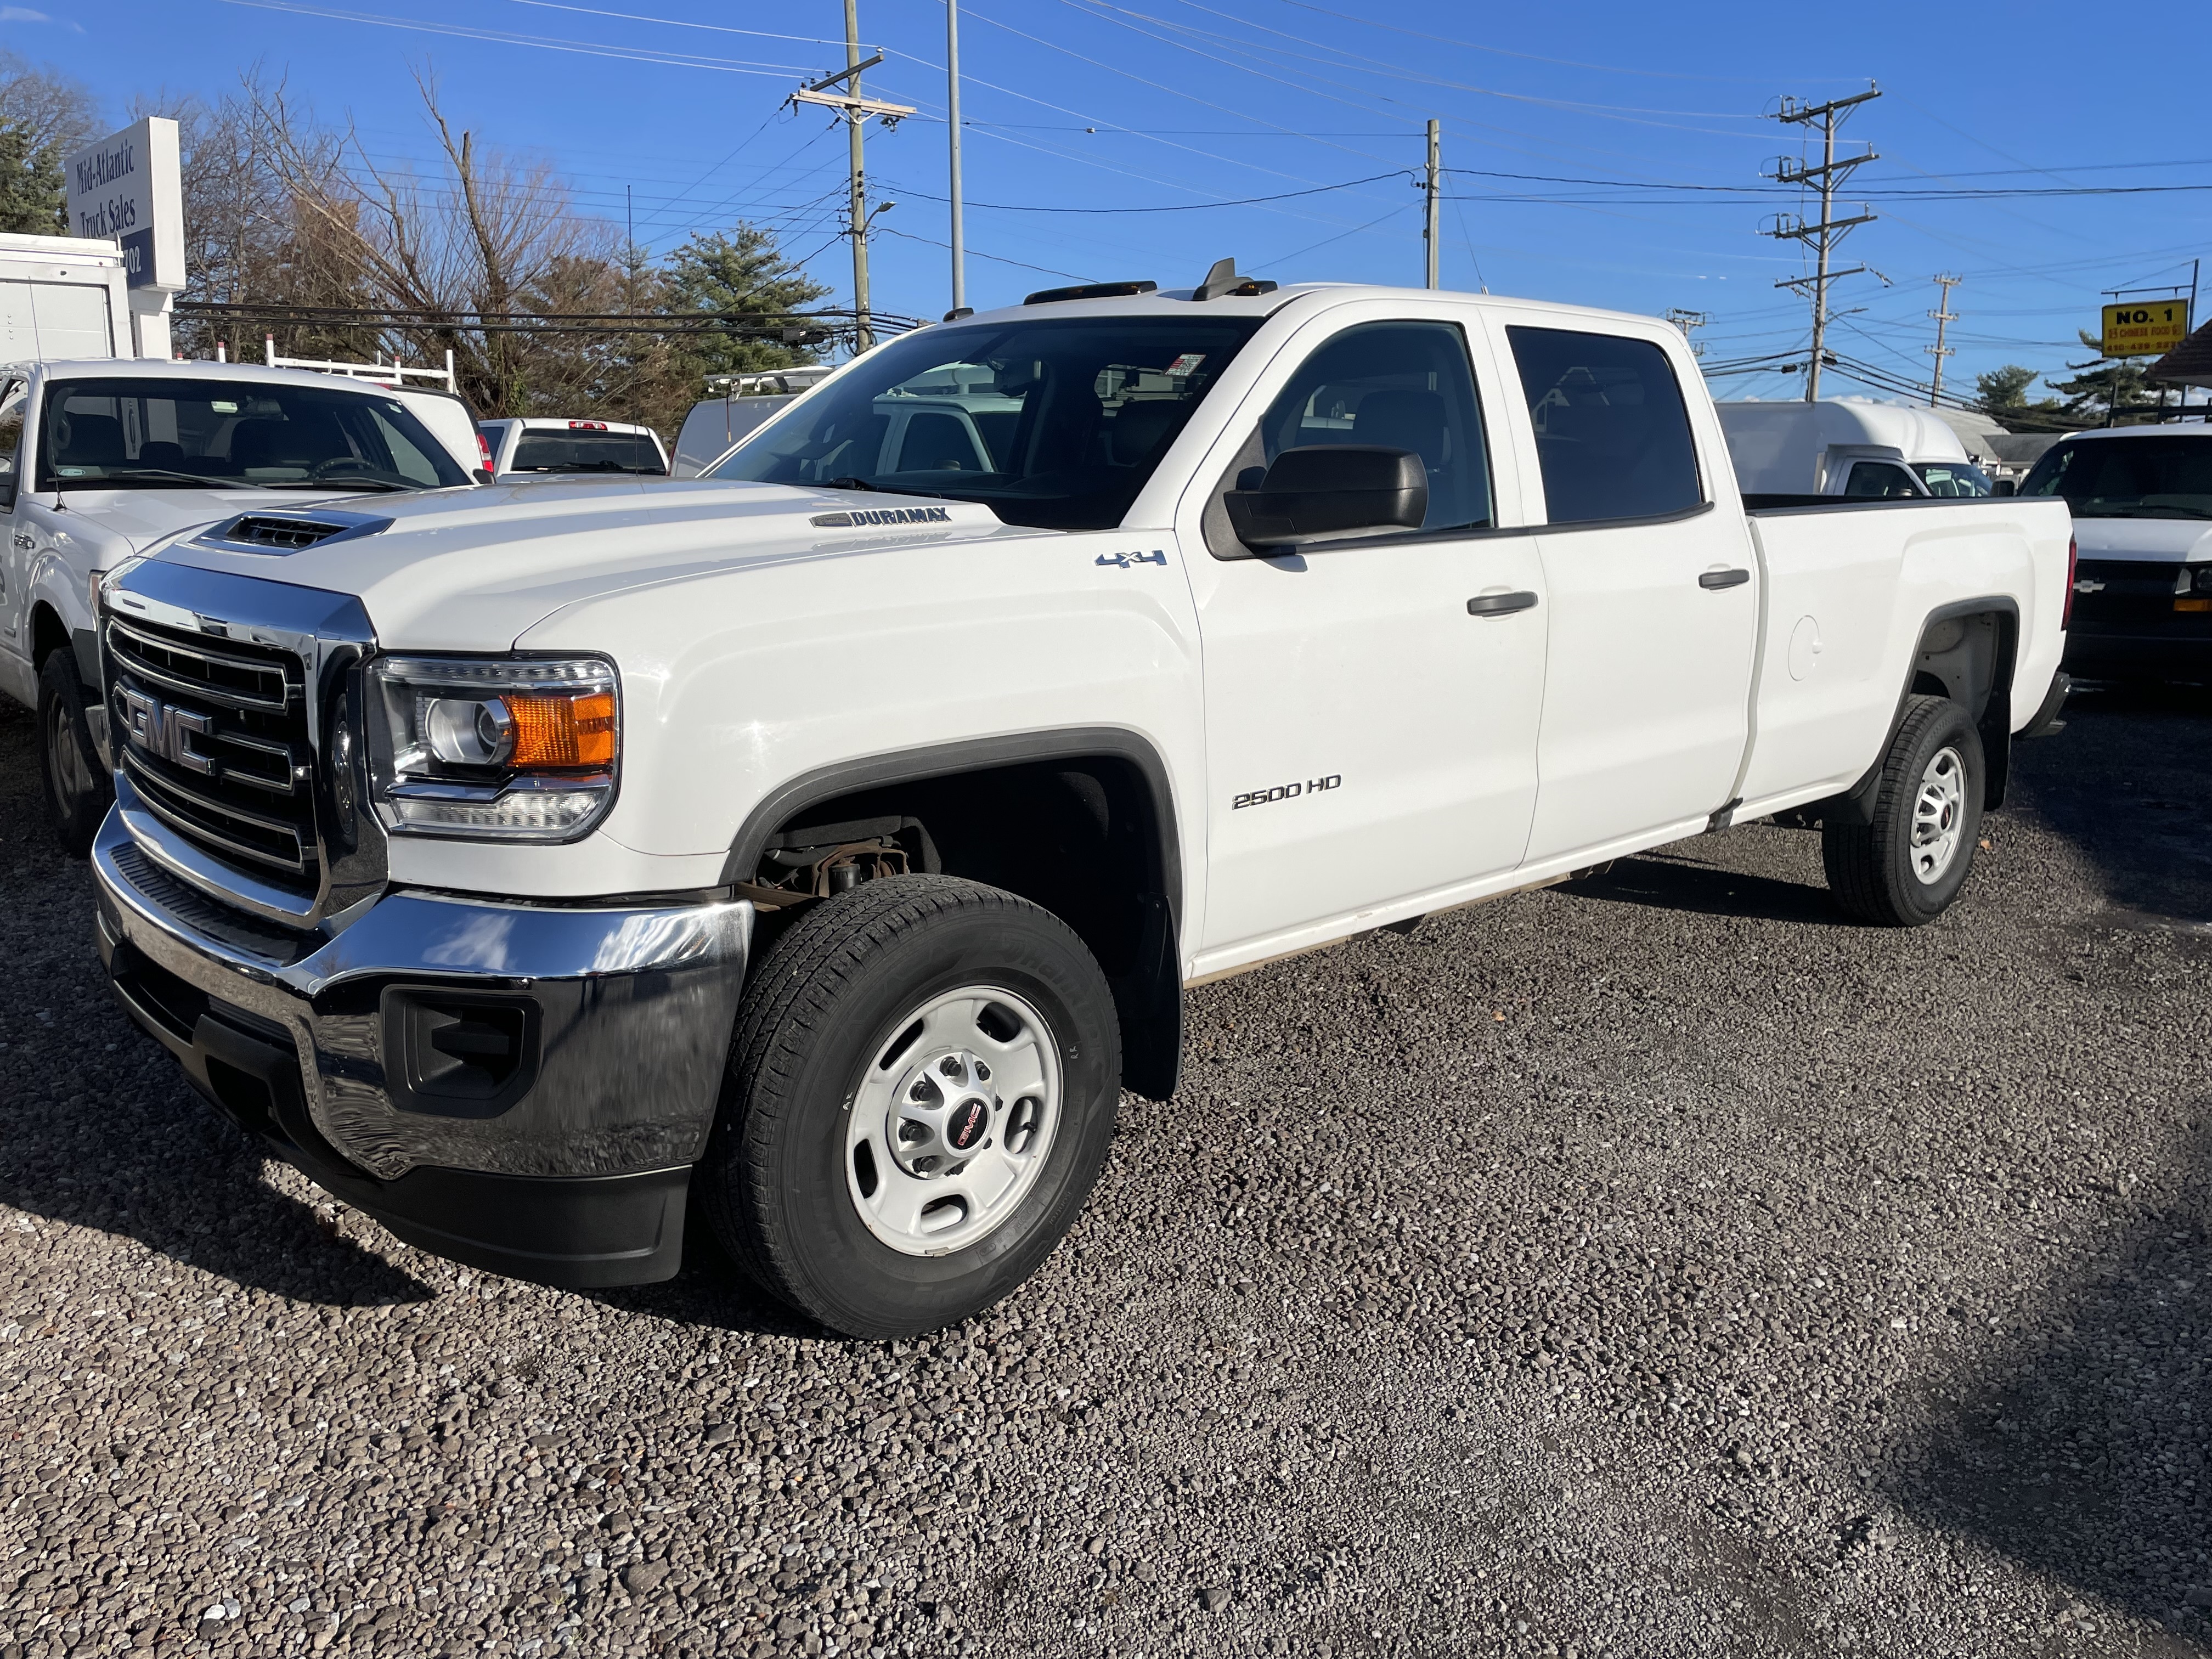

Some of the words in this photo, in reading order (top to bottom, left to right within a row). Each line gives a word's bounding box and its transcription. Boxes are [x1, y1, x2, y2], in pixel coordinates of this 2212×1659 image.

[77, 138, 135, 196] Mid-Atlantic
[80, 202, 108, 239] Truck
[109, 194, 136, 233] Sales
[2117, 309, 2154, 325] NO.
[2164, 308, 2172, 321] 1
[849, 507, 952, 528] DURAMAX
[127, 689, 216, 776] GMC
[1232, 782, 1301, 810] 2500
[1306, 774, 1341, 794] HD
[957, 1103, 981, 1146] GMC
